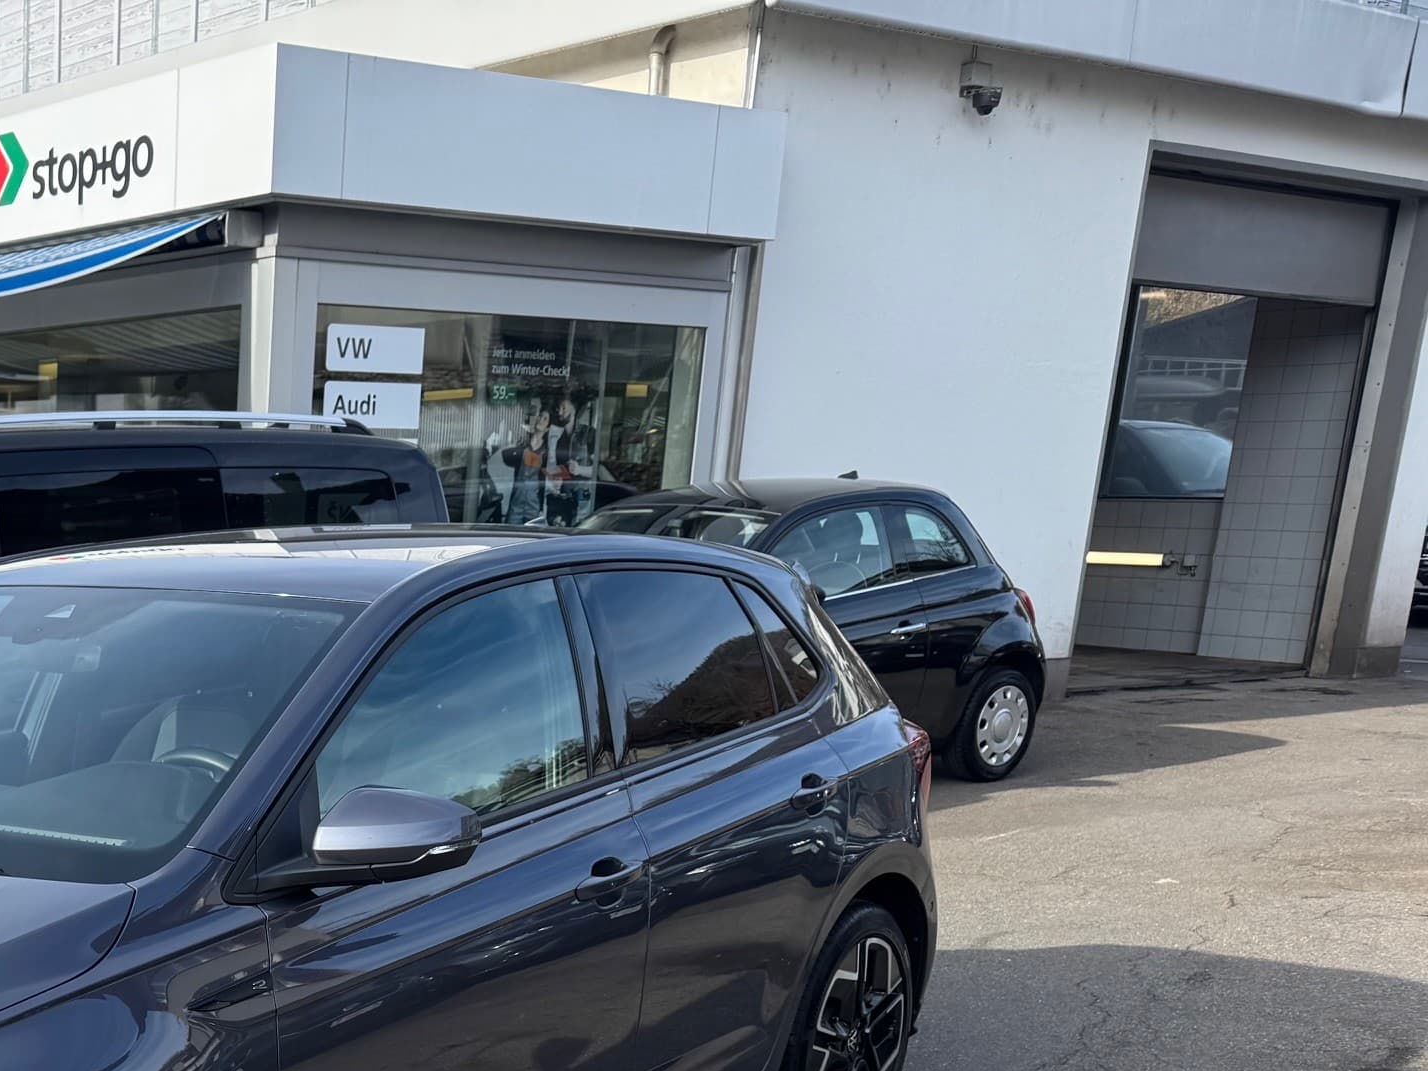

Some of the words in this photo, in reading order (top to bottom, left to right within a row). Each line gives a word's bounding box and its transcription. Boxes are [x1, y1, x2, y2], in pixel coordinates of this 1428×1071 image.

[336, 337, 373, 360] VW
[514, 348, 556, 361] anmelden
[492, 364, 509, 374] zum
[332, 394, 377, 416] Audi
